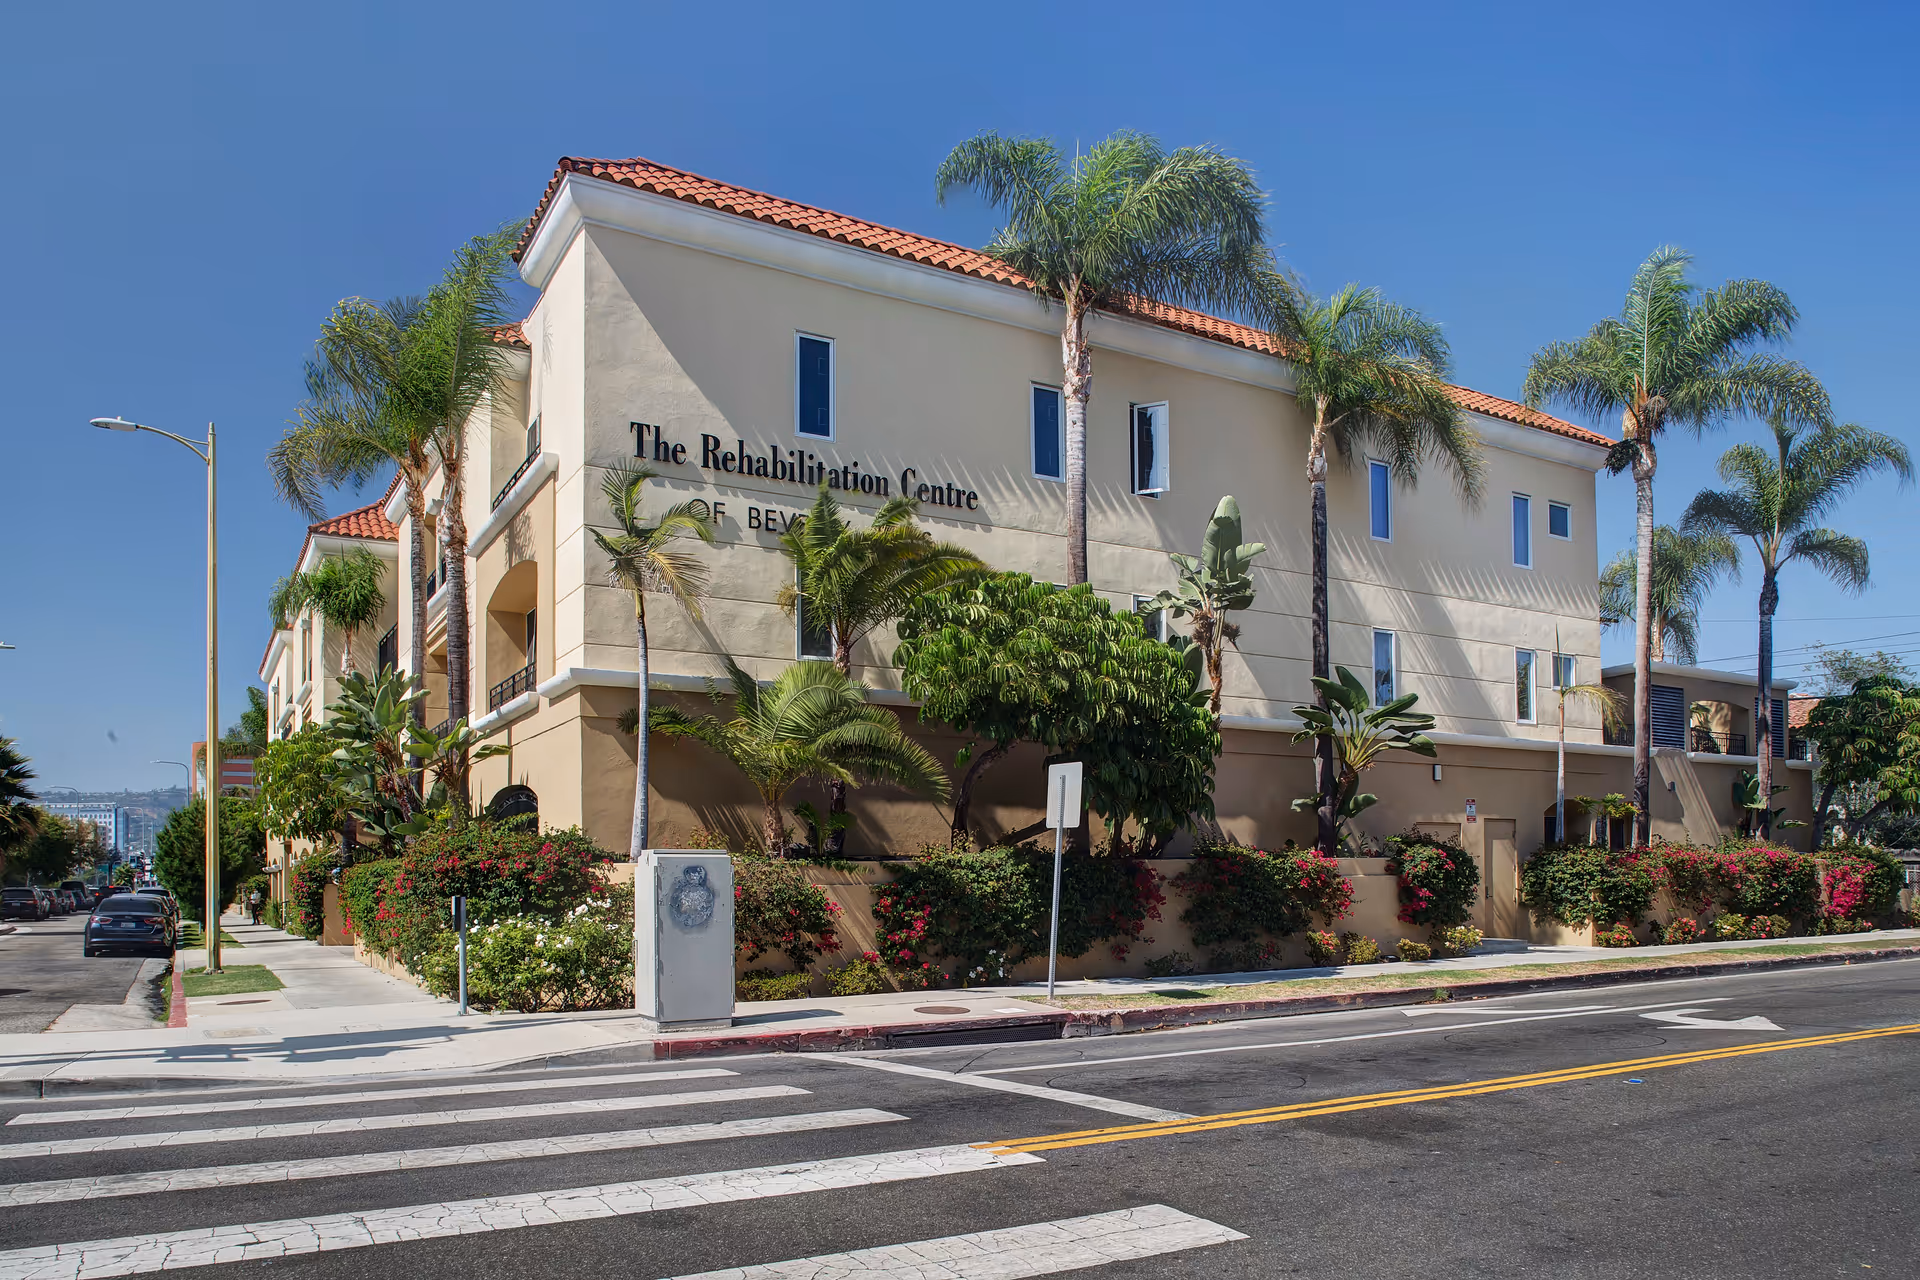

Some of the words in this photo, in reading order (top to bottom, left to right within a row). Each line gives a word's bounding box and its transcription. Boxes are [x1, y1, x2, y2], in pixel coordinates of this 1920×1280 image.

[630, 421, 687, 465] The
[701, 433, 890, 497] Rehabilitation
[901, 467, 979, 510] Centre
